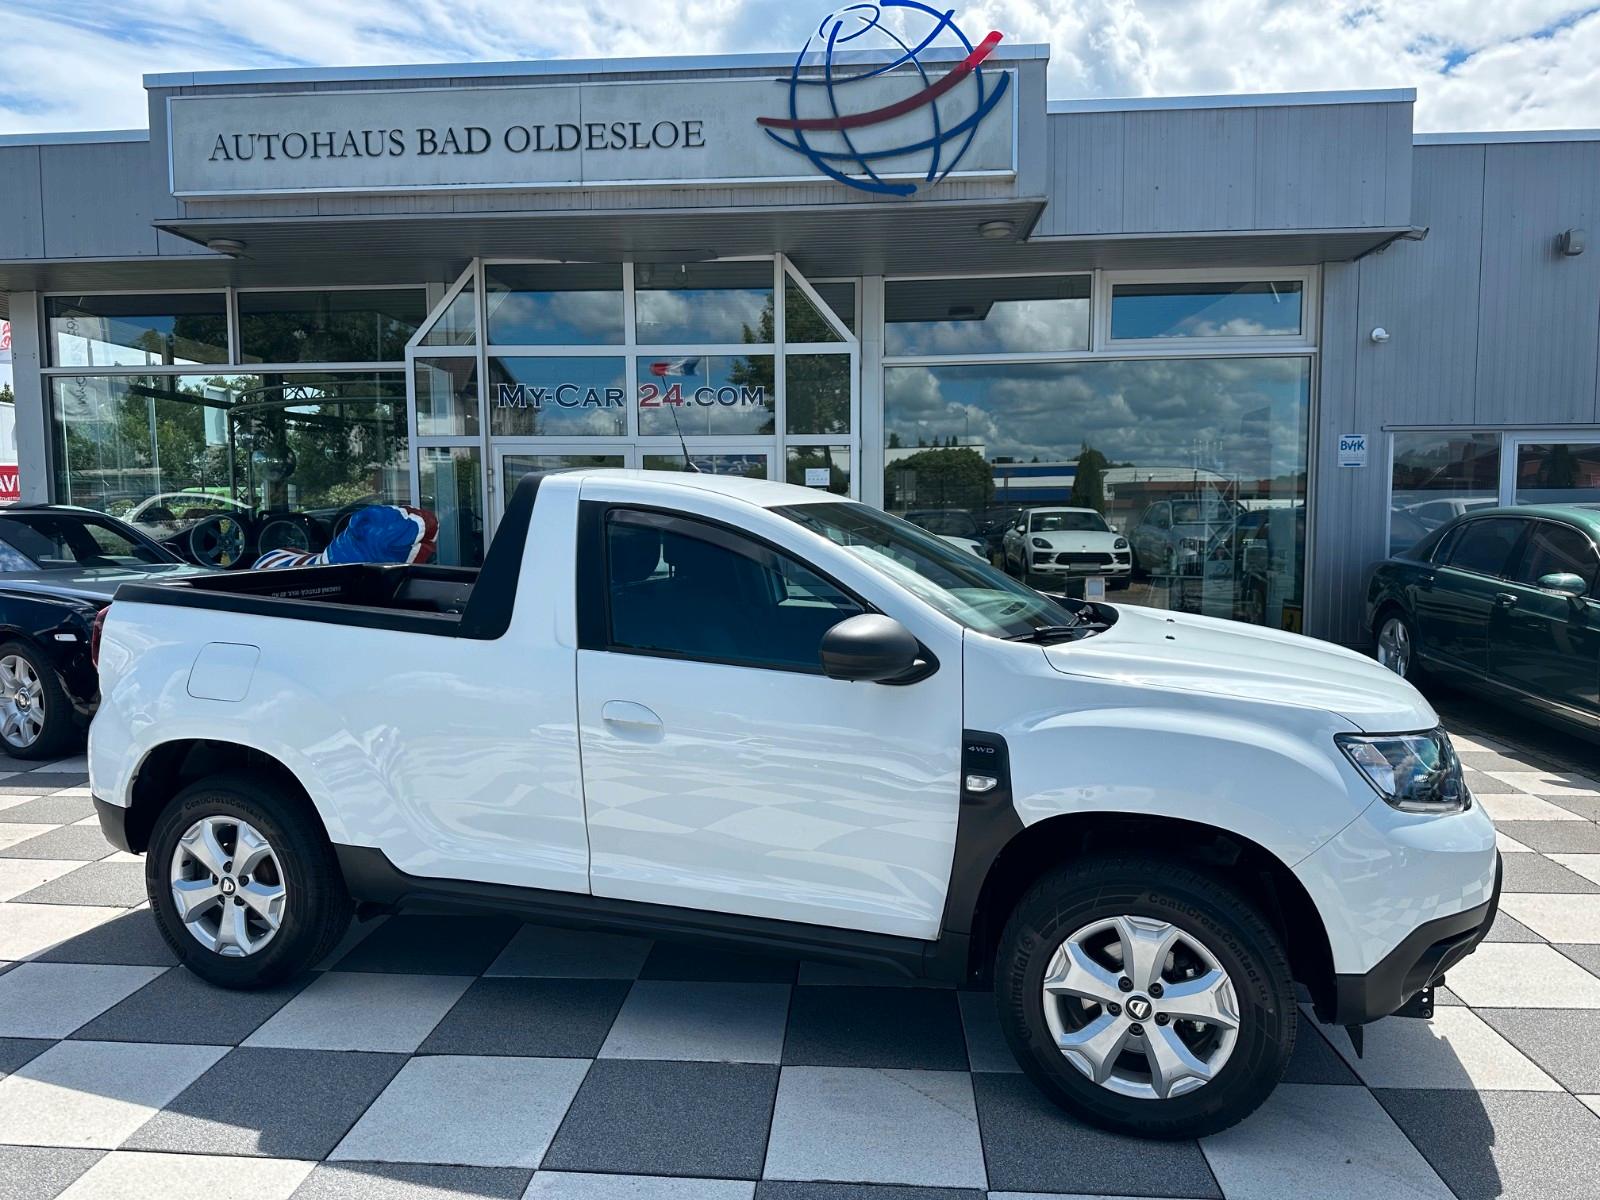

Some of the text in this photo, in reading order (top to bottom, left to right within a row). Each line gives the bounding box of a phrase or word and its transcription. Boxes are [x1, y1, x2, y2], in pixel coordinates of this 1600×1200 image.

[208, 120, 706, 161] AUTOHAUS BAD OLDESLOE
[968, 746, 995, 754] 4WD
